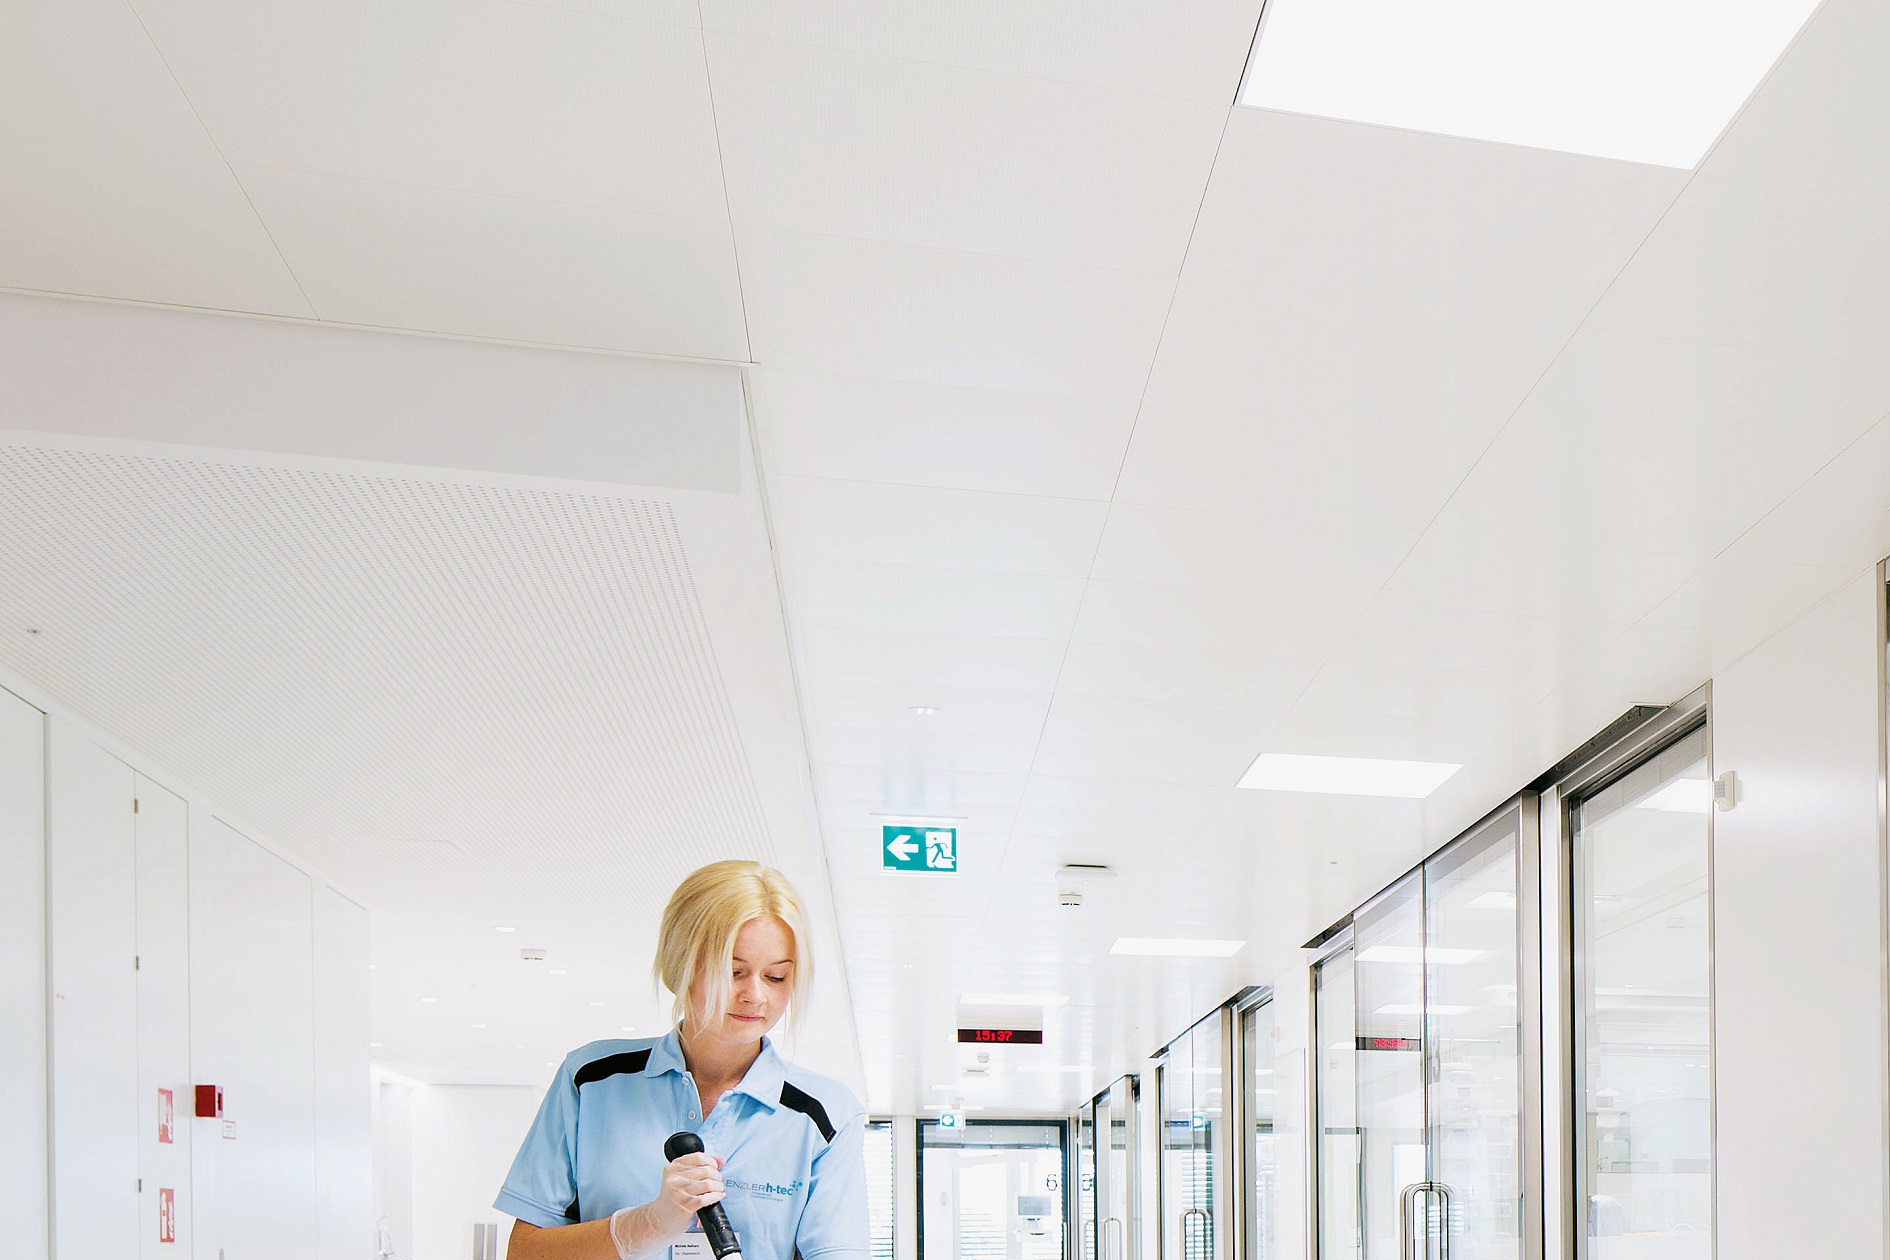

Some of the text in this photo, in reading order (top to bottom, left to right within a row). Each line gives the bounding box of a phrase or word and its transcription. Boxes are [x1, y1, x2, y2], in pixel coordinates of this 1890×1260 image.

[975, 1029, 1013, 1042] 15:37
[725, 1179, 794, 1196] ENZLERh-tec
[1046, 1173, 1058, 1192] 6
